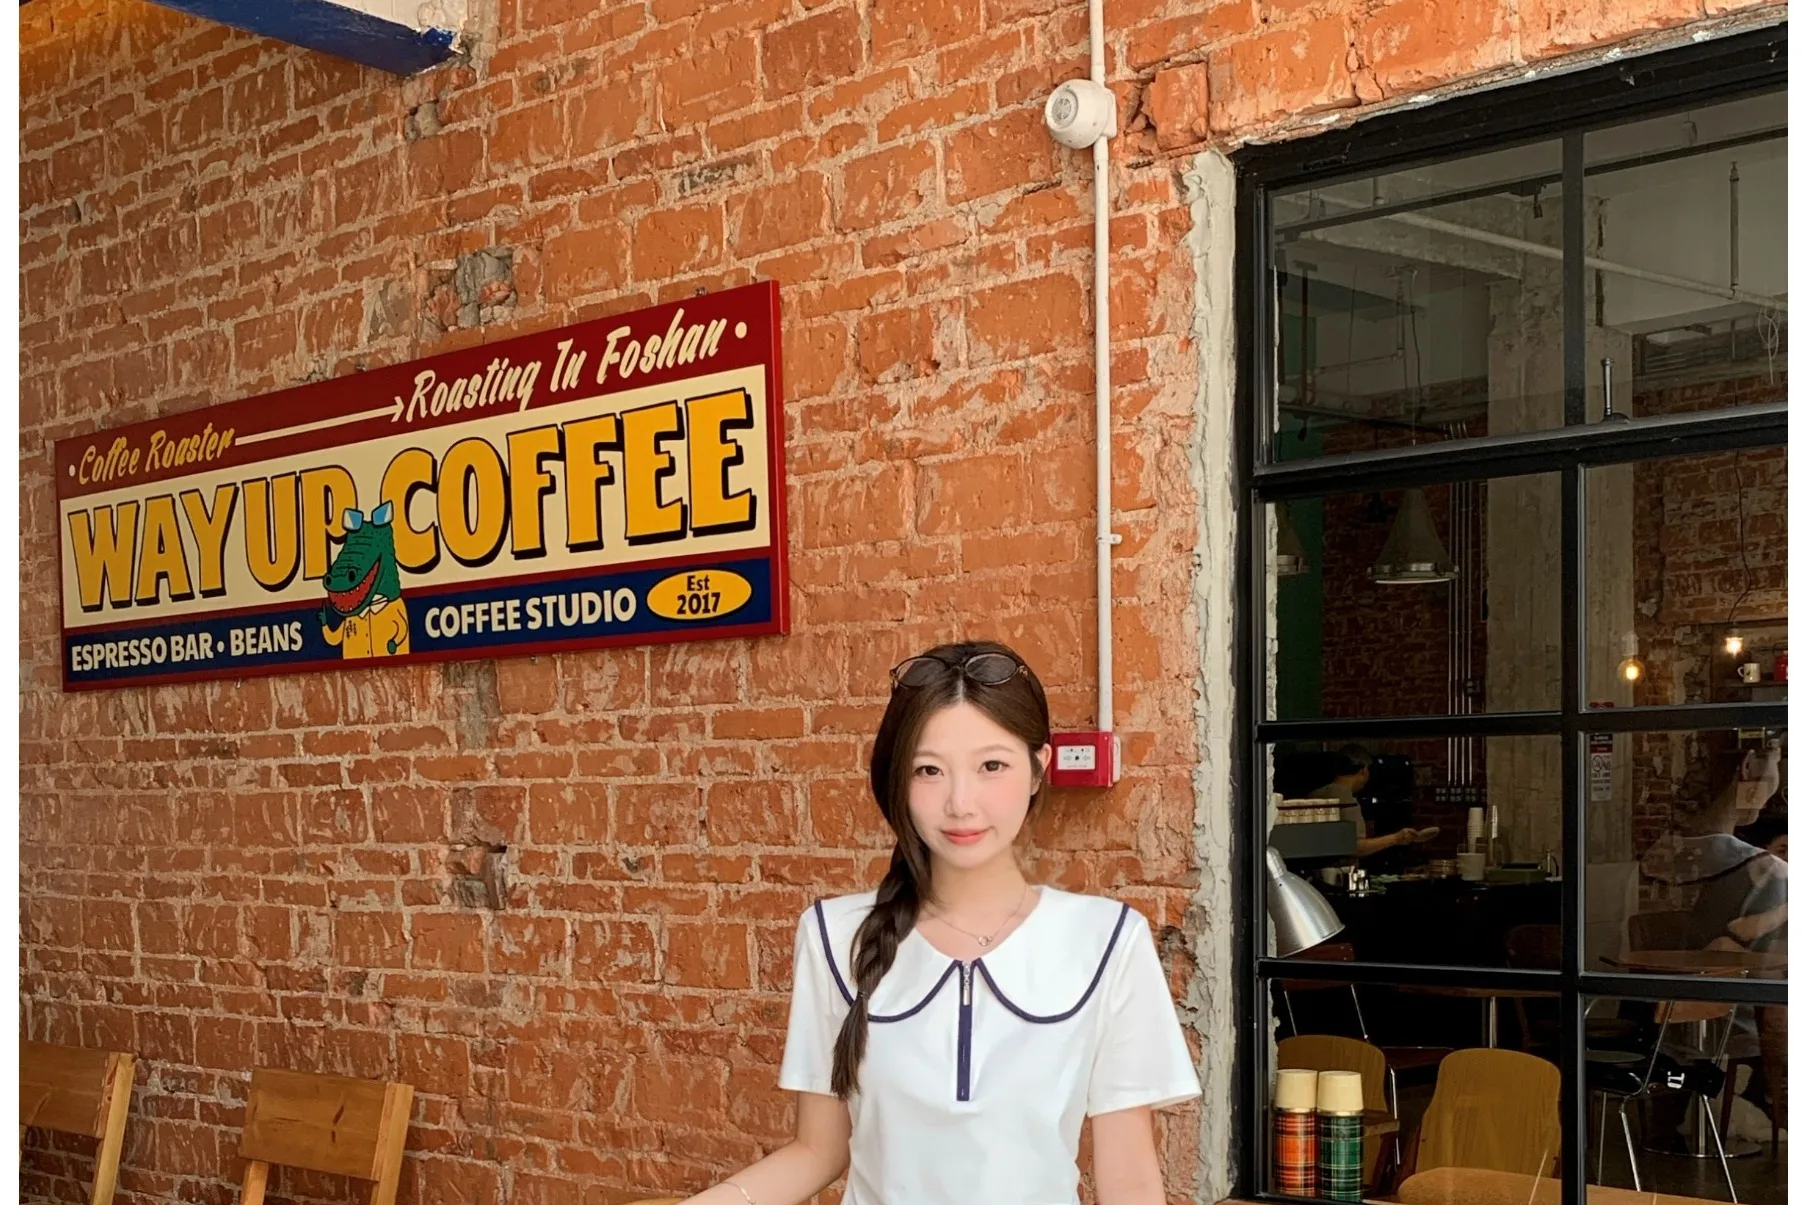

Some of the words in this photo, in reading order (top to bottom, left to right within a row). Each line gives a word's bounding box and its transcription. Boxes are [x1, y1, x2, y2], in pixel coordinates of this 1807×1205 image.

[405, 358, 542, 423] Roasting
[550, 338, 588, 393] In
[596, 308, 728, 385] Foshan
[79, 437, 138, 485] Coffee
[145, 421, 236, 473] Roaster
[380, 387, 757, 574] COFFEE
[676, 592, 721, 615] 2017
[686, 574, 710, 592] Est
[425, 600, 521, 638] COFFEE
[527, 587, 637, 629] STUDIO
[71, 636, 168, 671] ESPRESSO
[171, 633, 213, 663] BAR
[229, 620, 304, 656] BEANS
